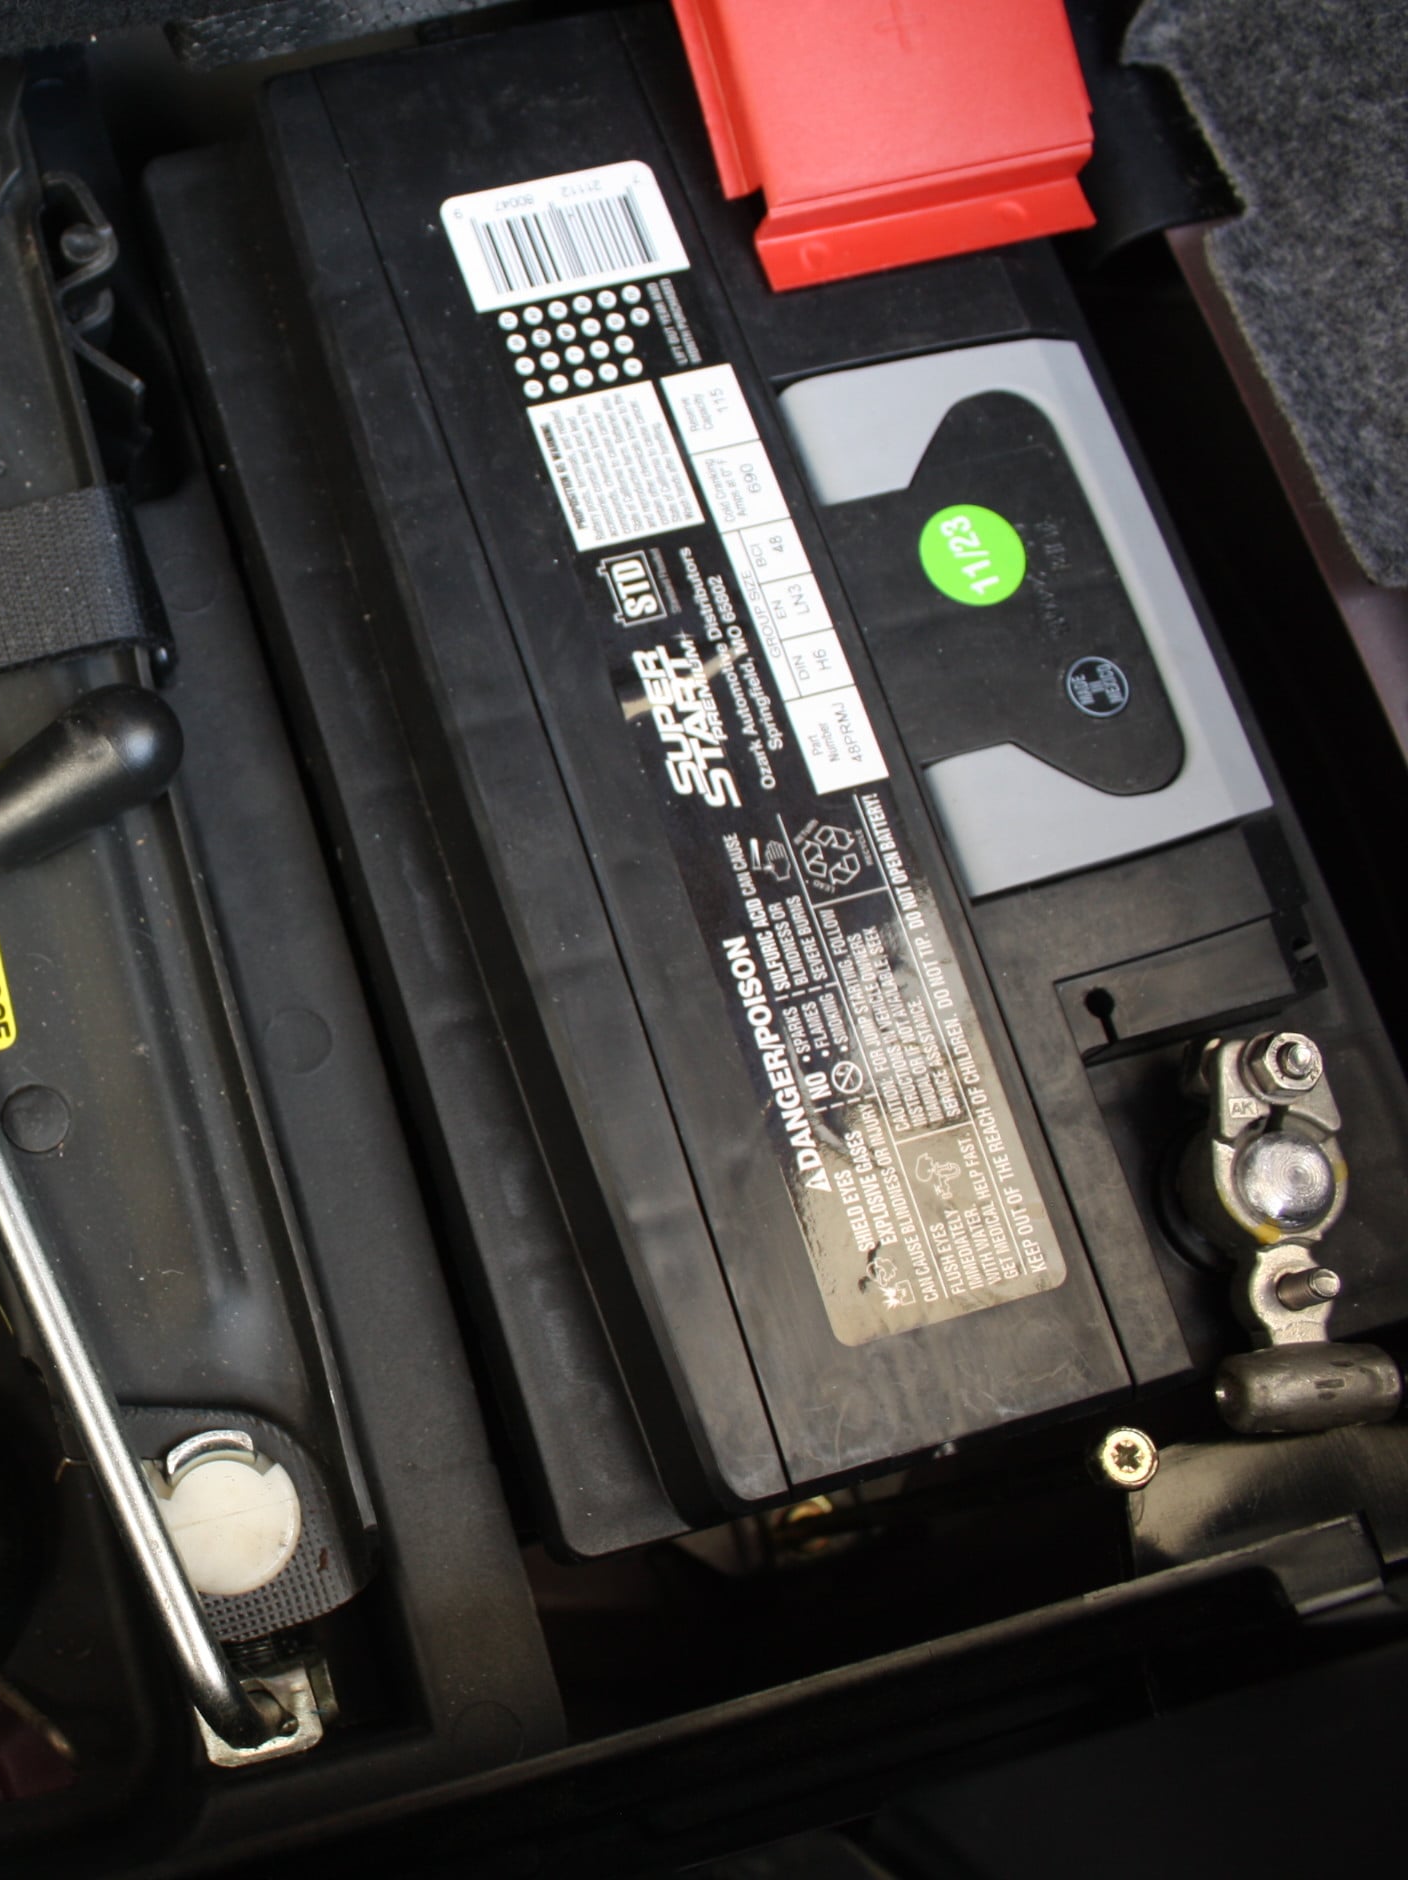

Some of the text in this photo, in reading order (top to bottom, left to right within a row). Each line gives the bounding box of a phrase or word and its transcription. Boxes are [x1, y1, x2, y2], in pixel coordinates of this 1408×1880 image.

[708, 386, 730, 413] 115
[738, 461, 762, 494] 690
[749, 542, 768, 568] BCI
[768, 534, 786, 553] 48
[940, 515, 1000, 595] 11/23
[608, 557, 660, 619] STD
[739, 569, 783, 659] GROUP SIZE
[770, 598, 788, 619] EN
[787, 582, 811, 615] LN3
[673, 545, 779, 790] Ozark Automotive Distributors
[706, 573, 788, 751] Springfield, MO 65802
[791, 653, 811, 681] DIN
[812, 647, 832, 671] H6
[631, 648, 707, 793] SUPER
[654, 645, 742, 808] START
[806, 733, 825, 757] Part
[815, 721, 841, 762] Number
[830, 700, 866, 764] 48PRMJ
[853, 827, 875, 866] RECYCLE
[722, 831, 791, 992] SULFURIC ACID CAN CAUSE
[767, 901, 809, 986] BLINDNESS OR
[784, 894, 828, 982] SEVERE BURNS
[818, 907, 848, 955] FOLLOW
[781, 1005, 811, 1054] SPARKS
[800, 1000, 831, 1049] FLAMES
[817, 992, 850, 1045] SMOKING
[846, 931, 929, 1127] INSTRUCTIONS IN VEHICLE OWNERS
[856, 1014, 881, 1048] JUMP
[860, 791, 1048, 1273] KEEP OUT OF THE REACH OF CHILDREN. DO NOT TIP. DO NOT OPEN BATTERY!
[861, 925, 946, 1122] MANUAL OR IF NOT AVAILABLE, SEEK
[722, 934, 824, 1172] DANGER/POISON
[803, 1069, 832, 1100] NO
[868, 1048, 890, 1072] FOR
[905, 995, 963, 1117] SERVICE ASSISTANCE.
[878, 1075, 911, 1132] CAUTION:
[1231, 1099, 1257, 1116] AK
[833, 1168, 877, 1252] SHIELD EYES
[843, 1129, 898, 1245] EXPLOSIVE GASES
[857, 1101, 941, 1303] CAN CAUSE BLINDNESS OR INJURY
[955, 1131, 1020, 1280] GET MEDICAL HELP FAST.
[928, 1221, 967, 1295] FLUSH EYES
[942, 1206, 985, 1290] IMMEDIATELY
[960, 1202, 1004, 1285] WITH WATER.
